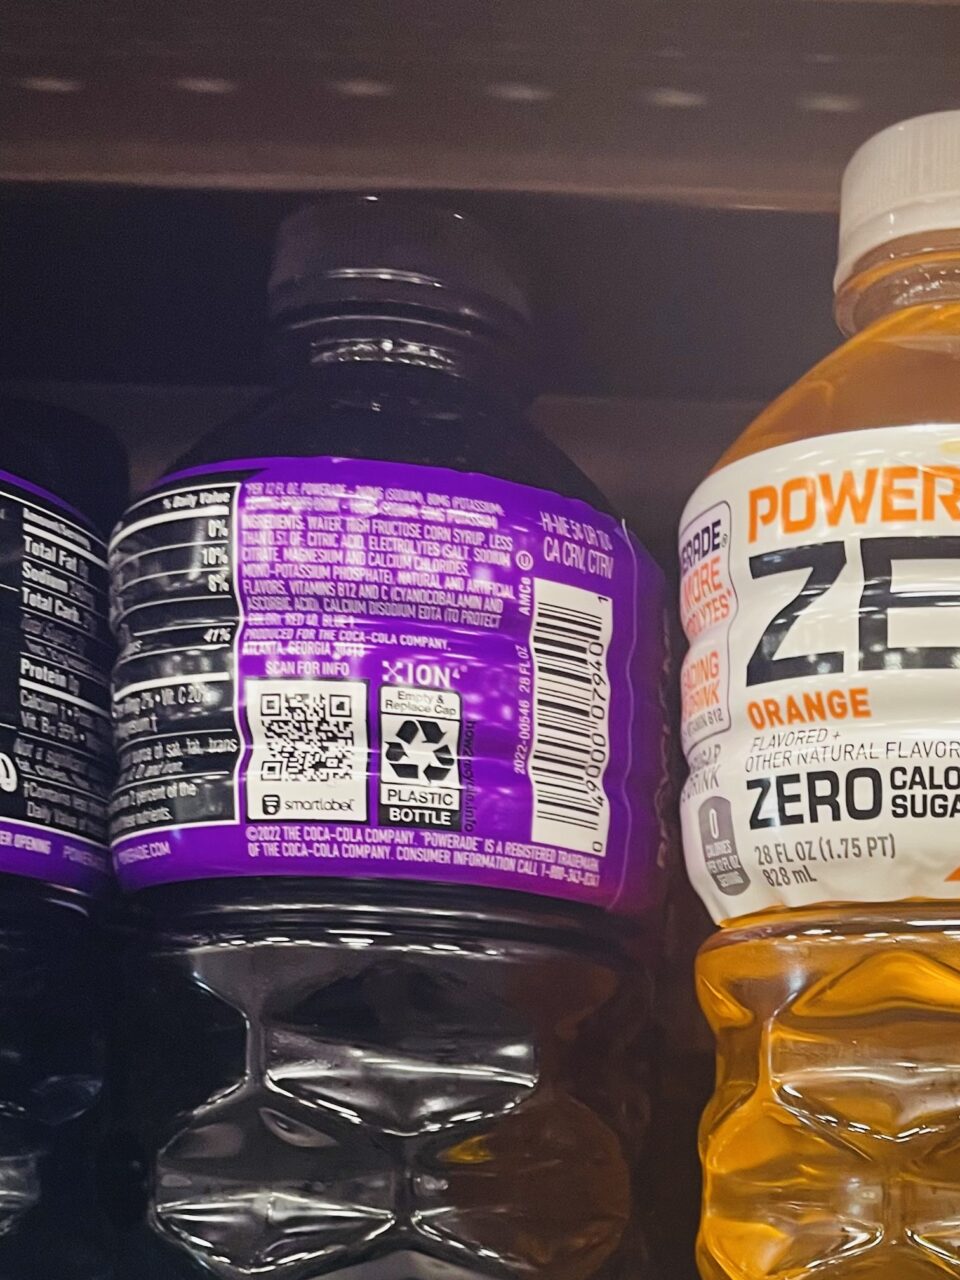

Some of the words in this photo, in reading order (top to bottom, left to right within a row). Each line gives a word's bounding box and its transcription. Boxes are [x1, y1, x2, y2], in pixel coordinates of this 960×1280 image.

[372, 519, 422, 538] FRUCTOSE
[22, 535, 57, 564] Total
[339, 630, 398, 647] COCA-COLA
[266, 660, 295, 676] SCAN
[297, 661, 319, 676] FOR
[322, 661, 350, 676] INFO
[397, 690, 435, 705] Empty
[385, 700, 431, 716] Replace
[433, 703, 457, 718] Cap
[747, 687, 872, 731] ORANGE
[750, 728, 829, 753] FLAVORED
[744, 749, 792, 773] OTHER
[796, 742, 880, 766] NATURAL
[387, 788, 454, 807] PLASTIC
[746, 767, 883, 831] ZERO
[389, 808, 452, 826] BOTTLE
[283, 828, 301, 842] THE
[303, 828, 363, 845] COCA-COLA
[260, 843, 280, 857] THE
[282, 844, 340, 859] COCA-COLA
[398, 847, 451, 866] CONSUMER
[754, 845, 773, 867] 28
[775, 843, 795, 864] FL
[796, 840, 817, 863] OZ
[818, 836, 862, 863] (1.75
[866, 833, 897, 860] PT)
[762, 867, 791, 888] 828
[793, 865, 818, 885] mL
